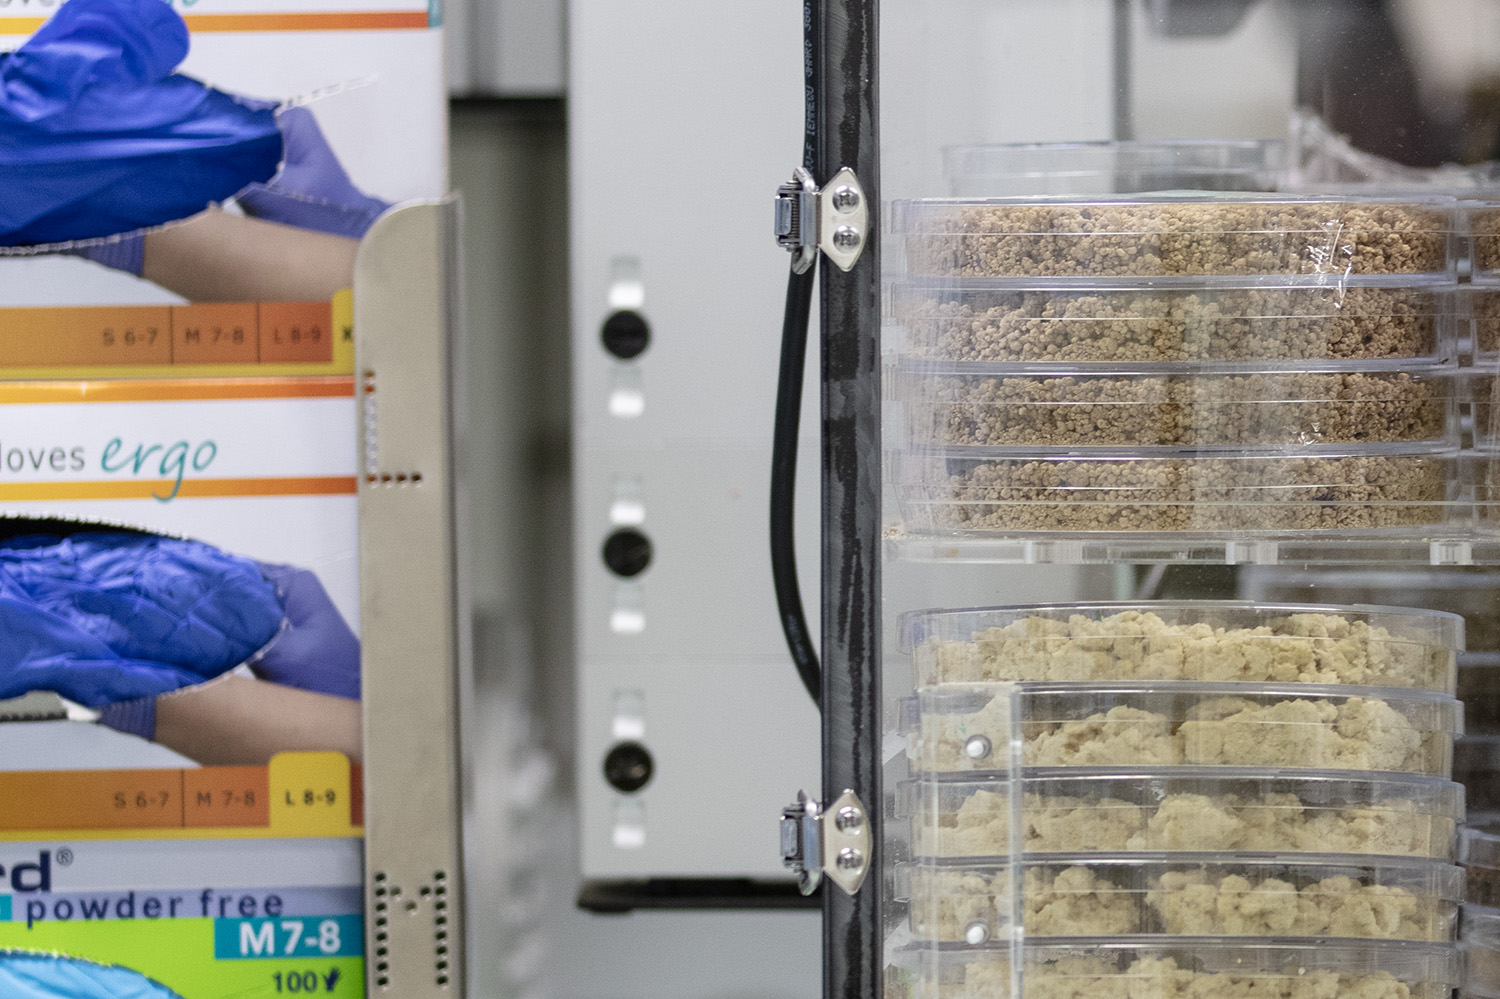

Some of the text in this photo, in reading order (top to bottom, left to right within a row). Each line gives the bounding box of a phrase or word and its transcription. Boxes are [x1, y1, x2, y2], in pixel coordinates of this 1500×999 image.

[103, 328, 115, 346] S
[185, 328, 199, 345] M
[101, 437, 217, 503] ergo
[114, 790, 169, 808] S 6-7
[197, 789, 256, 807] M 7-8
[285, 789, 336, 805] L 8-9
[26, 888, 283, 930] powder free
[274, 970, 317, 993] 100
